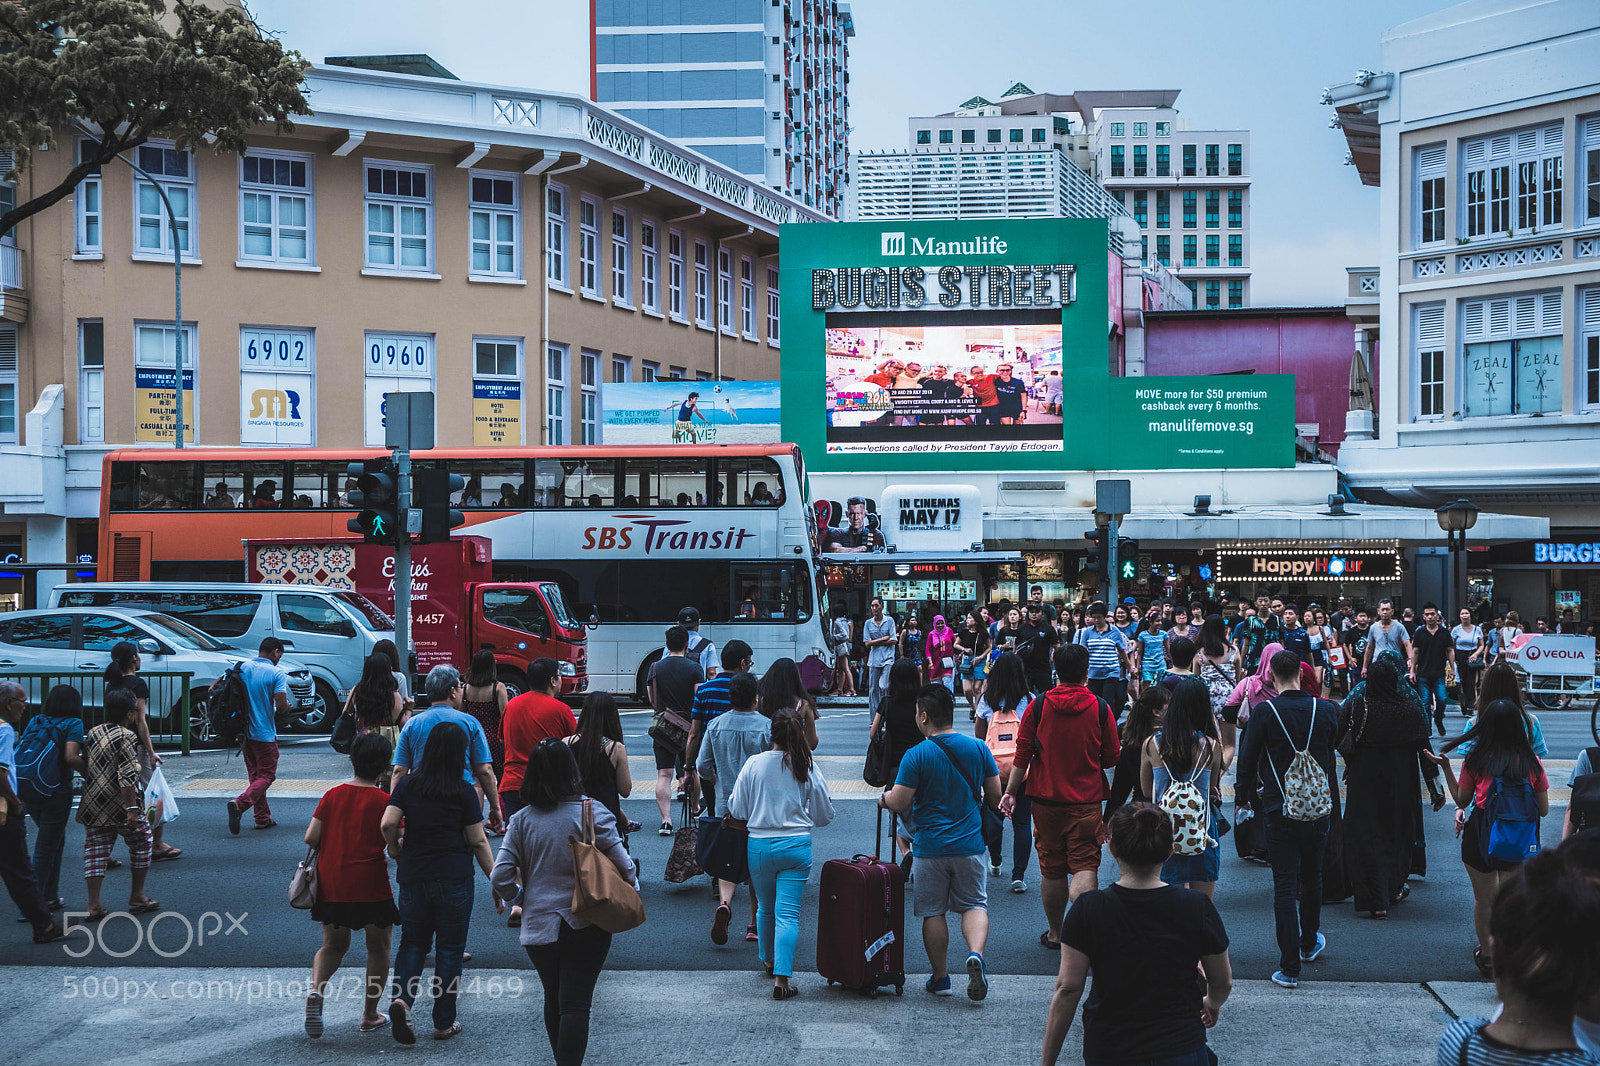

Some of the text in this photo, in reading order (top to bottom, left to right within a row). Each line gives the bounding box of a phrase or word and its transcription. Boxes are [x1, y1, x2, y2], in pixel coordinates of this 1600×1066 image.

[910, 236, 1008, 256] Manulife
[812, 263, 1077, 310] BUGIS STREET
[247, 339, 304, 361] 6902
[371, 344, 424, 365] 0960
[1473, 357, 1508, 371] ZEAL
[1523, 353, 1560, 367] ZEAL
[1135, 389, 1267, 401] MOVE more for $50 premium
[1141, 401, 1261, 413] cashback every 6 months.
[699, 421, 713, 429] YOUR
[1148, 419, 1254, 435] manulifemove.sg
[675, 428, 717, 444] MOVE?
[931, 444, 942, 453] by
[944, 443, 986, 451] President
[990, 443, 1018, 452] Tayyip
[1021, 442, 1061, 452] Erdogan.
[899, 498, 960, 508] IN CINEMAS
[900, 509, 960, 525] MAY 17
[582, 519, 758, 555] SBS Transit
[416, 613, 445, 624] 4457
[1543, 650, 1585, 659] VEOLIA
